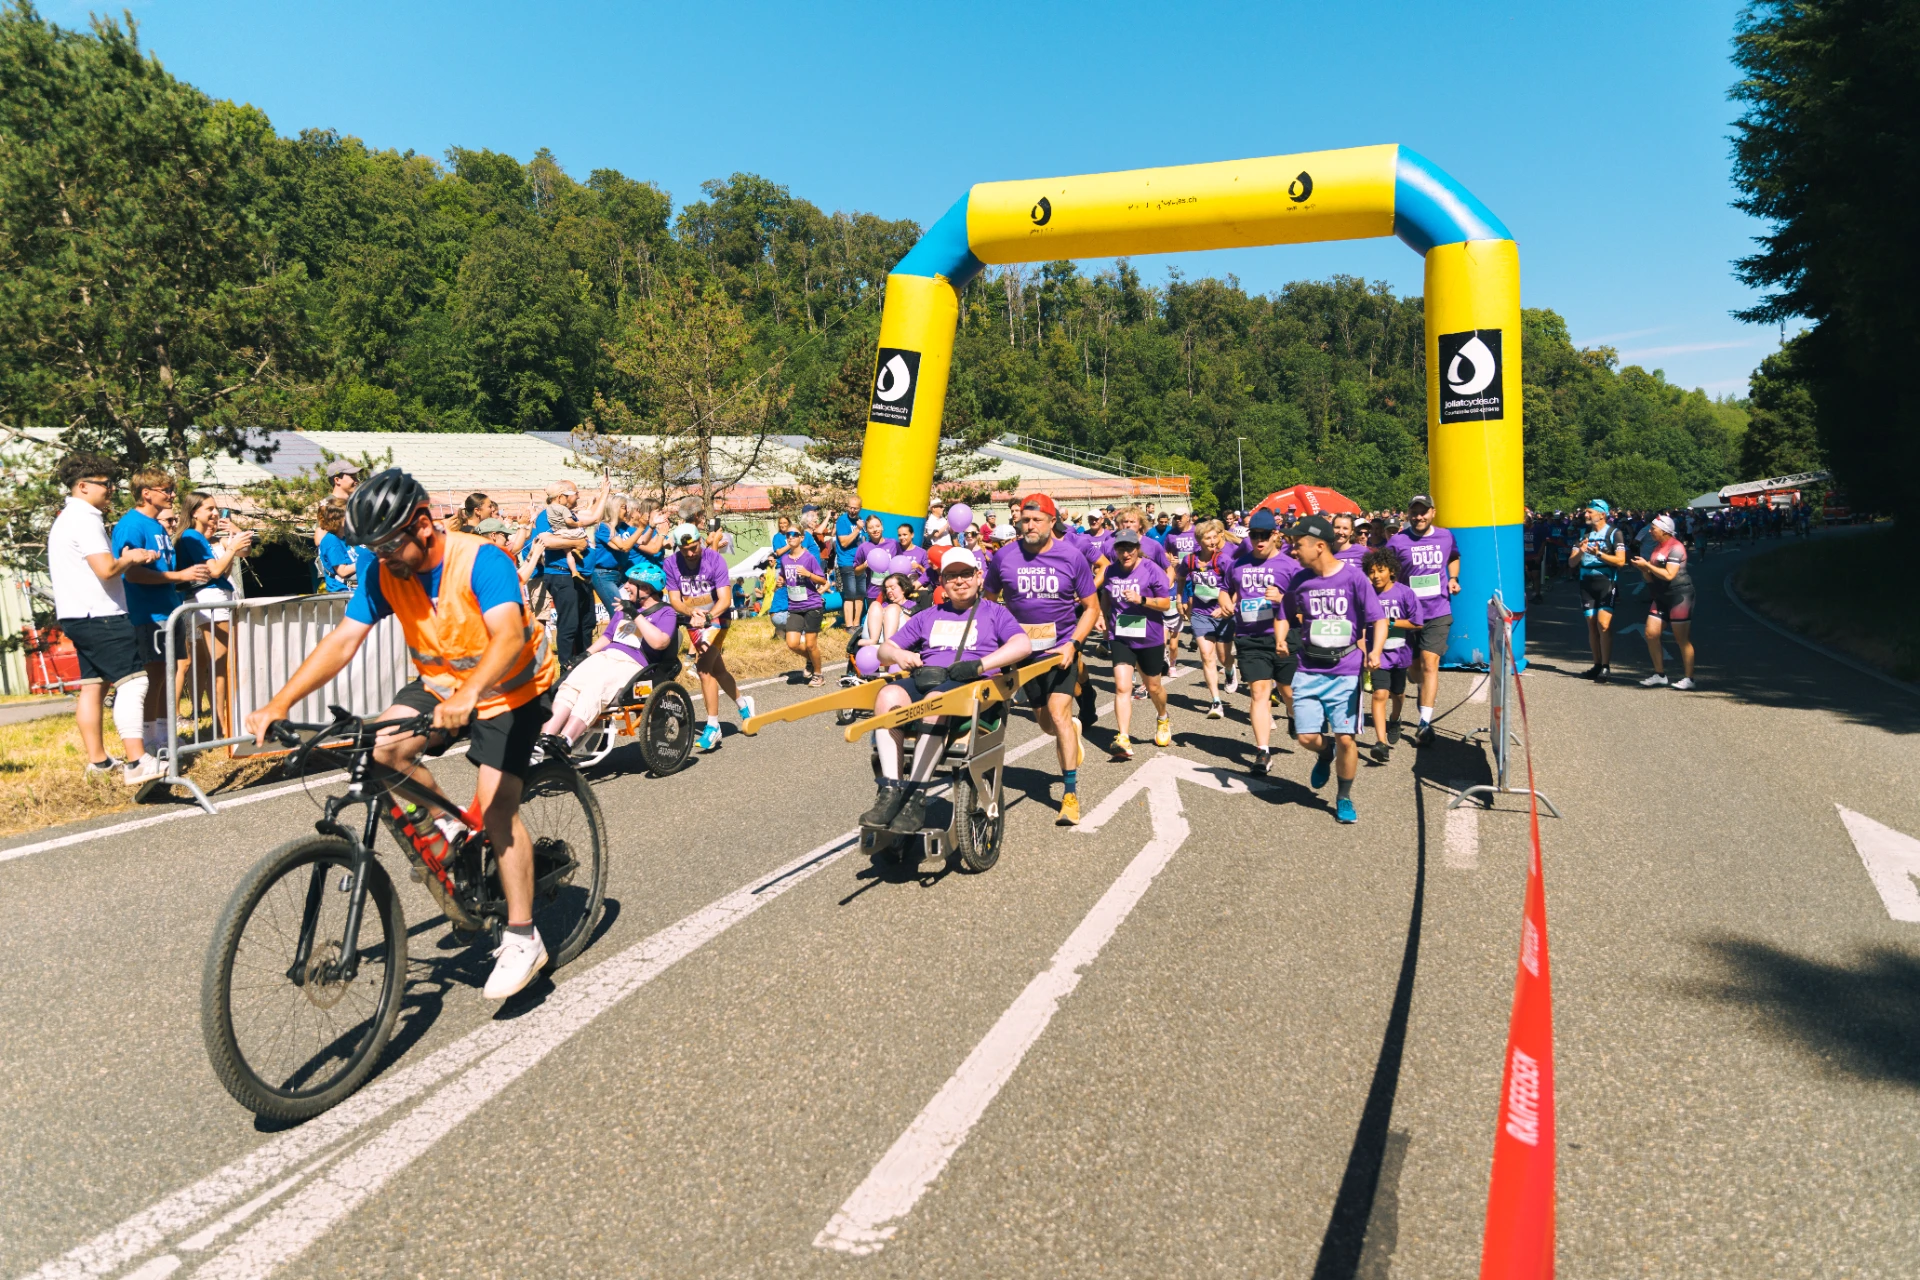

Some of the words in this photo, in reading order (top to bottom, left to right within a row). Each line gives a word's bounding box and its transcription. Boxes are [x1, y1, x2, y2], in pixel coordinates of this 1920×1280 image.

[1412, 551, 1443, 565] DUO
[1017, 567, 1046, 575] COURSE
[1018, 575, 1059, 593] DUO
[1242, 573, 1275, 588] DUO
[1309, 597, 1348, 616] DUO
[1028, 626, 1052, 639] 102
[1321, 621, 1341, 635] 26
[1505, 1045, 1540, 1147] RAIFFEISEN
